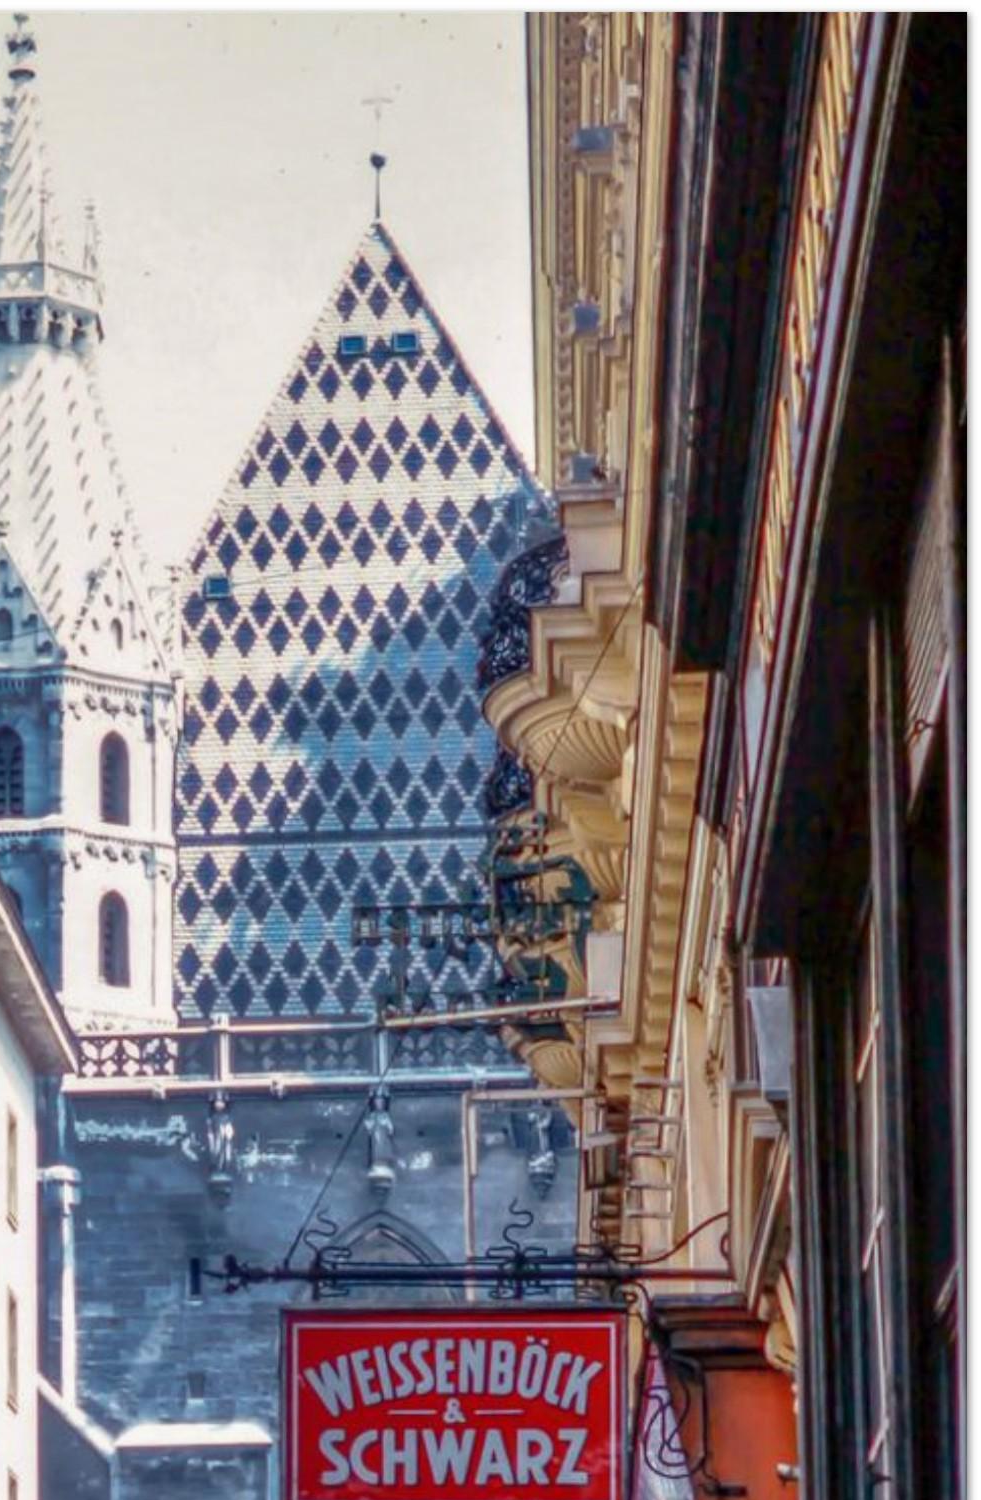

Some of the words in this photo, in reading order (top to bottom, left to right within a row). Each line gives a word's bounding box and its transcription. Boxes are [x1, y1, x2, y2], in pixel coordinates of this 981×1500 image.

[303, 1335, 603, 1418] WEISSENBÖCK
[442, 1398, 467, 1424] &
[318, 1428, 589, 1486] SCHWARZ
